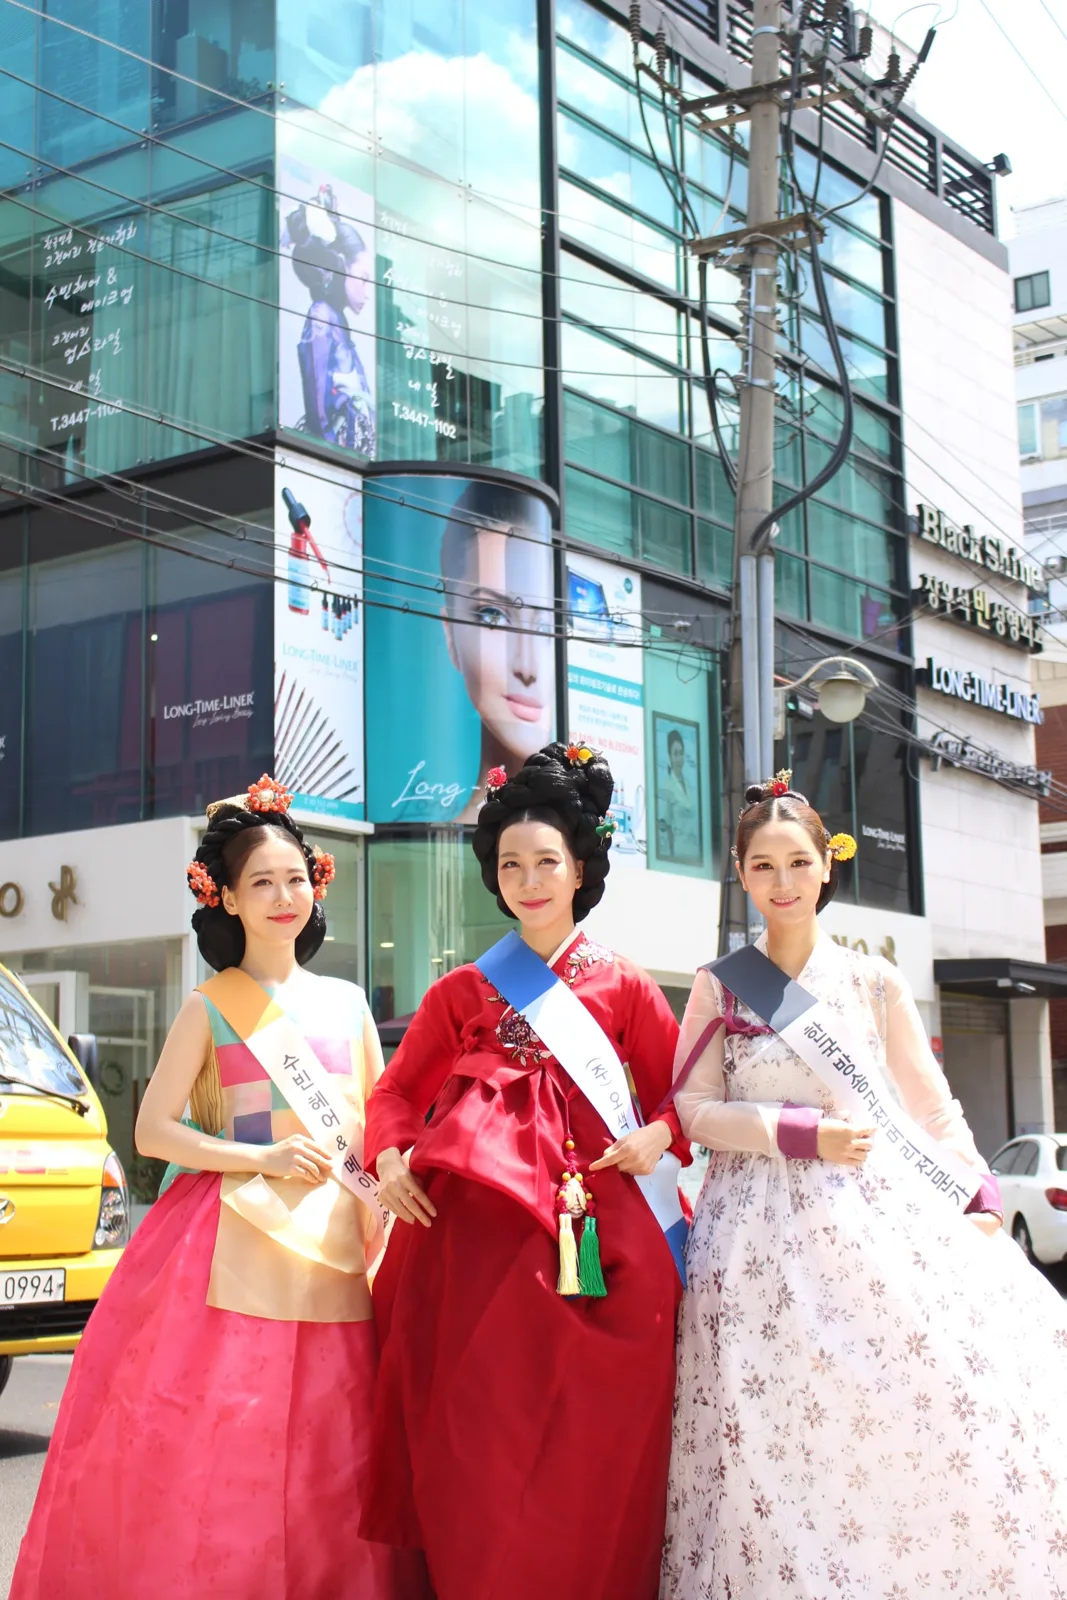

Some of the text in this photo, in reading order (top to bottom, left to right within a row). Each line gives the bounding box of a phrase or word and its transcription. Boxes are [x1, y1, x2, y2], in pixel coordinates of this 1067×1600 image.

[44, 266, 117, 310] 수빈헤어 &
[80, 285, 134, 312] 메이크업
[392, 402, 457, 439] T.3447-1102
[164, 690, 255, 719] LONG-TIME-LINER
[927, 656, 1044, 725] LONG-TIME-LINER
[282, 1054, 341, 1128] 수빈헤어
[335, 1135, 348, 1151] &
[5, 1274, 54, 1300] 0994
